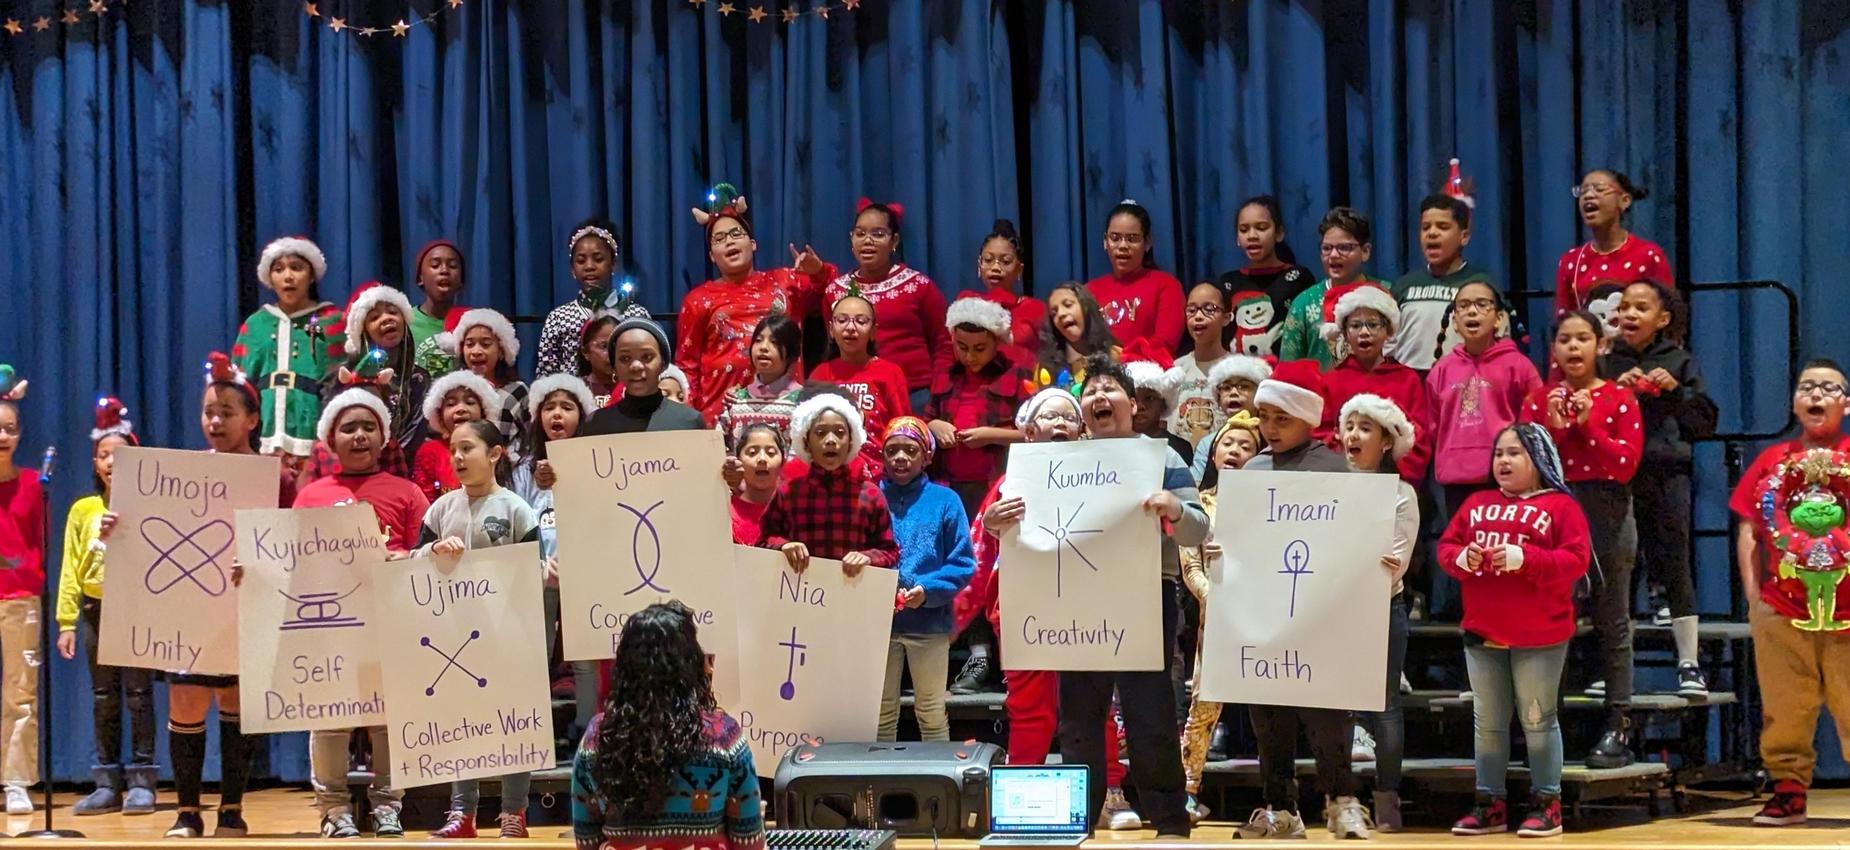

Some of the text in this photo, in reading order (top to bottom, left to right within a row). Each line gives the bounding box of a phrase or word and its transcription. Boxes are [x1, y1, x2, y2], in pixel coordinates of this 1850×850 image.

[1099, 297, 1141, 325] OY
[1406, 285, 1459, 300] BROOKLY
[592, 447, 681, 491] Ujama
[1047, 460, 1121, 490] Kuumba
[138, 459, 228, 518] Umoja
[1266, 488, 1339, 522] Imani
[1470, 504, 1552, 535] NORTH
[253, 527, 380, 572] Kujichagulia
[410, 573, 497, 617] Ujima
[780, 570, 826, 607] Nia
[131, 625, 202, 672] Unity
[1023, 615, 1125, 656] Creativity
[293, 655, 344, 684] Self
[1241, 645, 1312, 683] Faith
[265, 691, 385, 721] Determinati
[402, 708, 543, 749] Collective Work
[418, 743, 550, 779] Responsibility
